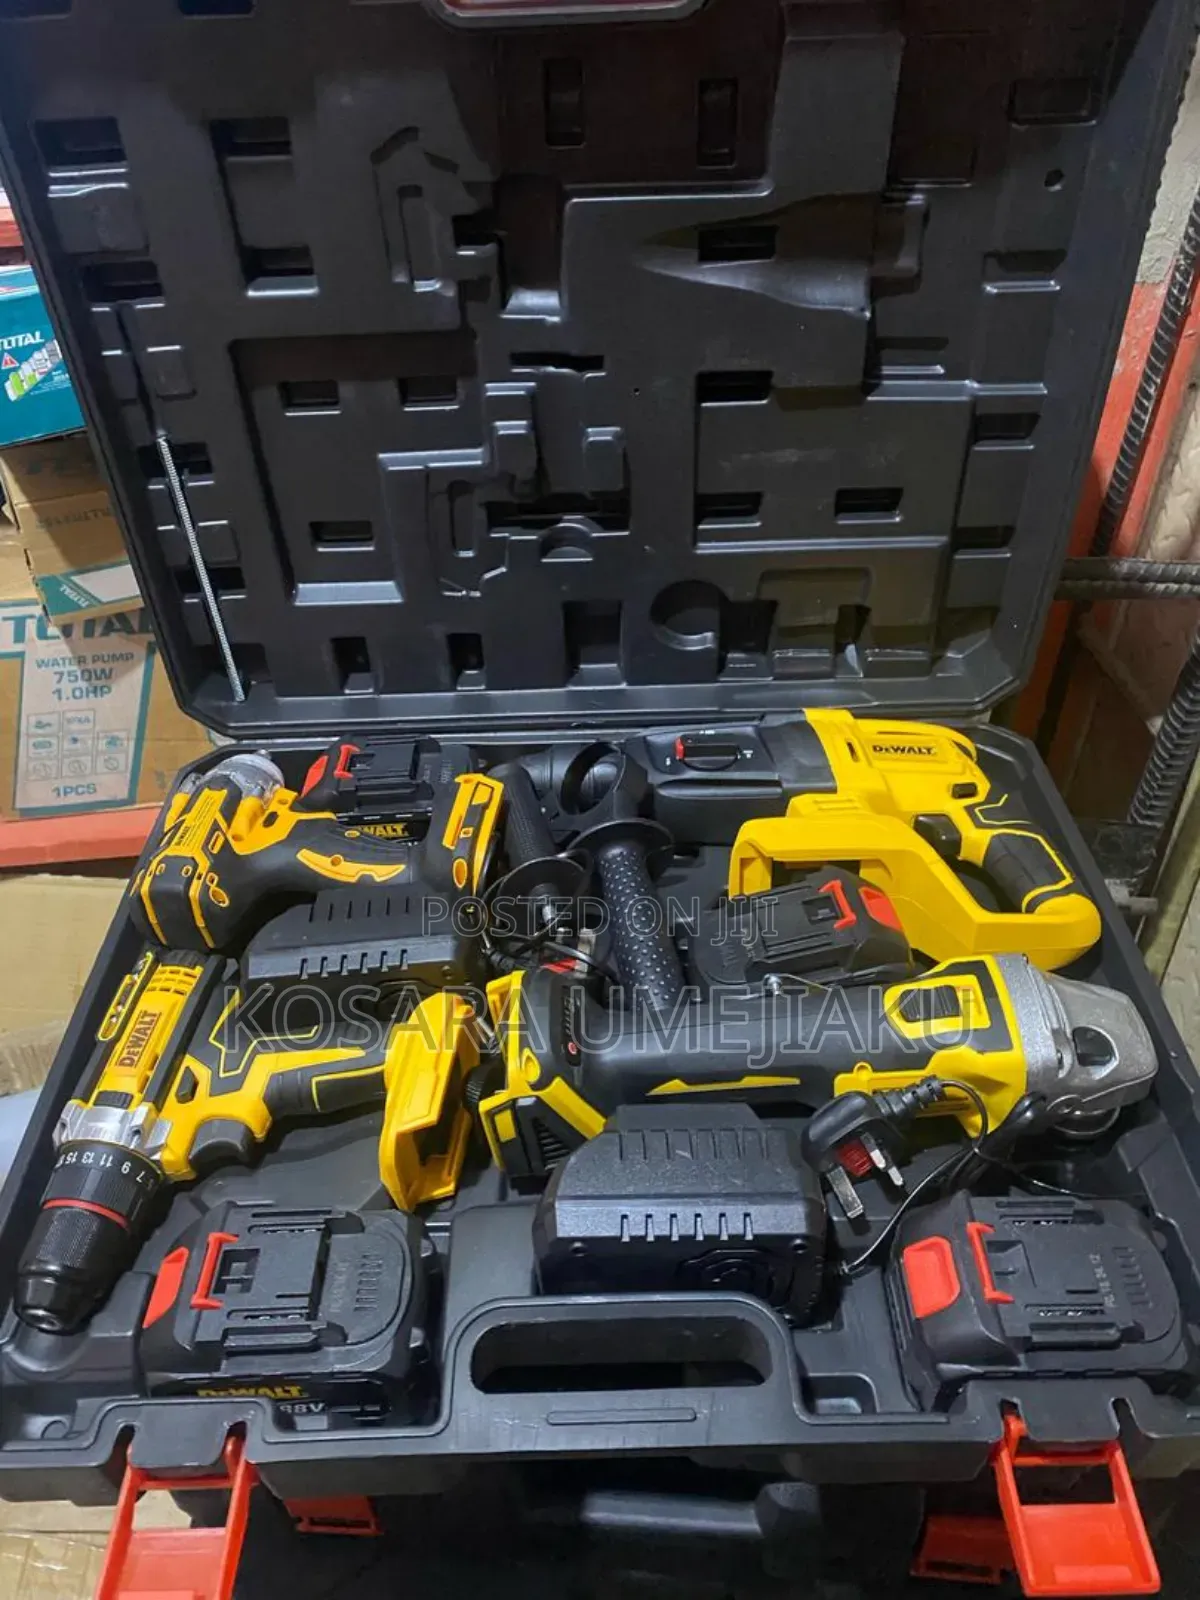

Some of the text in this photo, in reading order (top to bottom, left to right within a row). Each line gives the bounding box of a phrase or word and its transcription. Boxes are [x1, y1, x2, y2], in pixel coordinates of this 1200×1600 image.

[36, 652, 134, 668] WATER PUMP
[53, 667, 114, 684] 750W
[52, 685, 112, 701] 1.0HP
[52, 783, 97, 797] 1PCS
[81, 1151, 96, 1164] 13
[99, 1153, 114, 1168] 11
